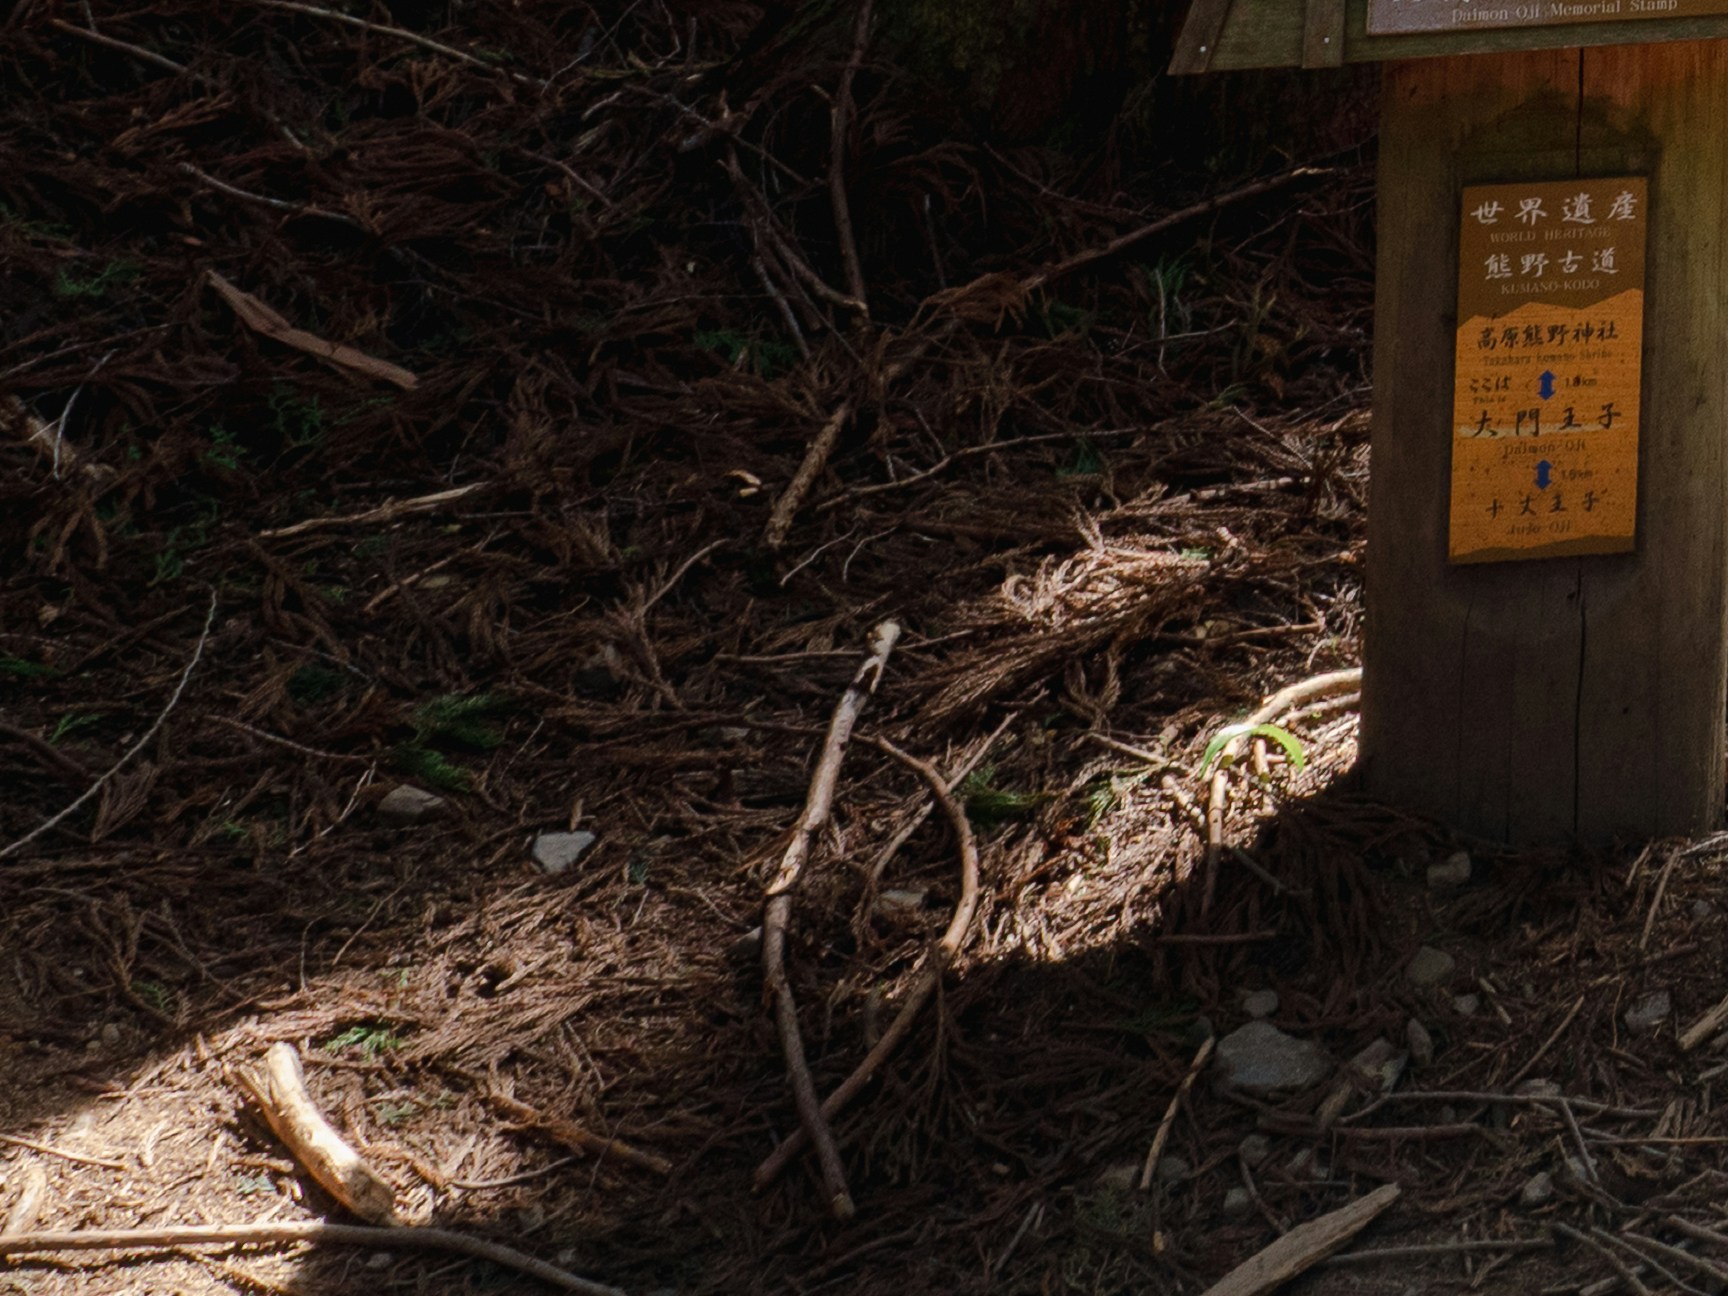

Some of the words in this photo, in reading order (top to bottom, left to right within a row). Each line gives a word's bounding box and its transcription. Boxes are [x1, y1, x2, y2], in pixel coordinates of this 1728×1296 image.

[1551, 0, 1621, 16] Memorial
[1470, 190, 1638, 226] 世界遺産
[1489, 230, 1536, 244] WORLD
[1544, 226, 1611, 241] HERITAGE
[1484, 246, 1620, 281] 熊野古道
[1477, 319, 1619, 351] 高原熊野神社
[1469, 375, 1511, 394] ここは
[1473, 402, 1621, 438] 大門王子
[1485, 490, 1600, 519] 十丈王子
